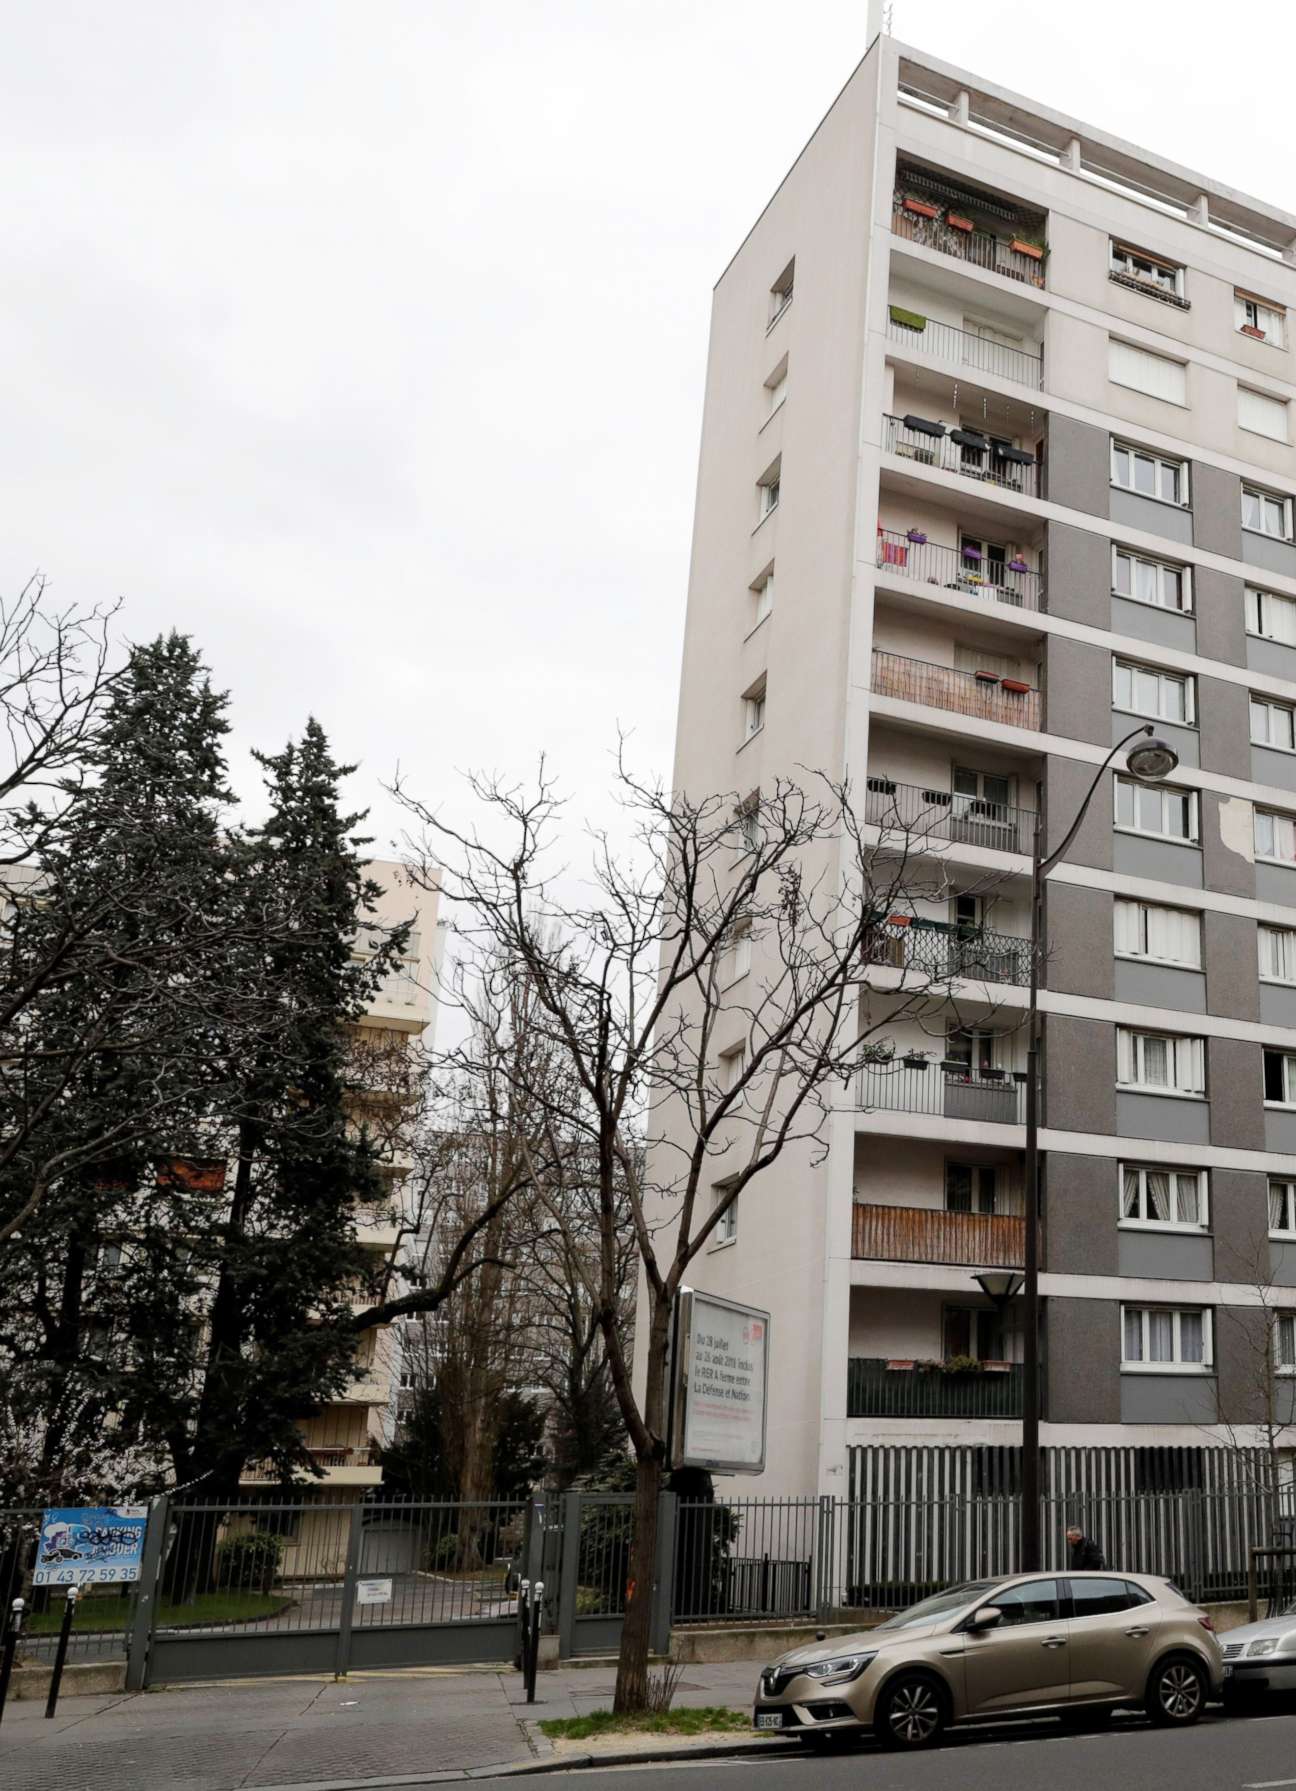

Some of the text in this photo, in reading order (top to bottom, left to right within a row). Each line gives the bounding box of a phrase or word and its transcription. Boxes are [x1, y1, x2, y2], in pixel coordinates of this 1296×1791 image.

[702, 1366, 713, 1379] RER
[35, 1568, 137, 1583] 01 43 72 59 35
